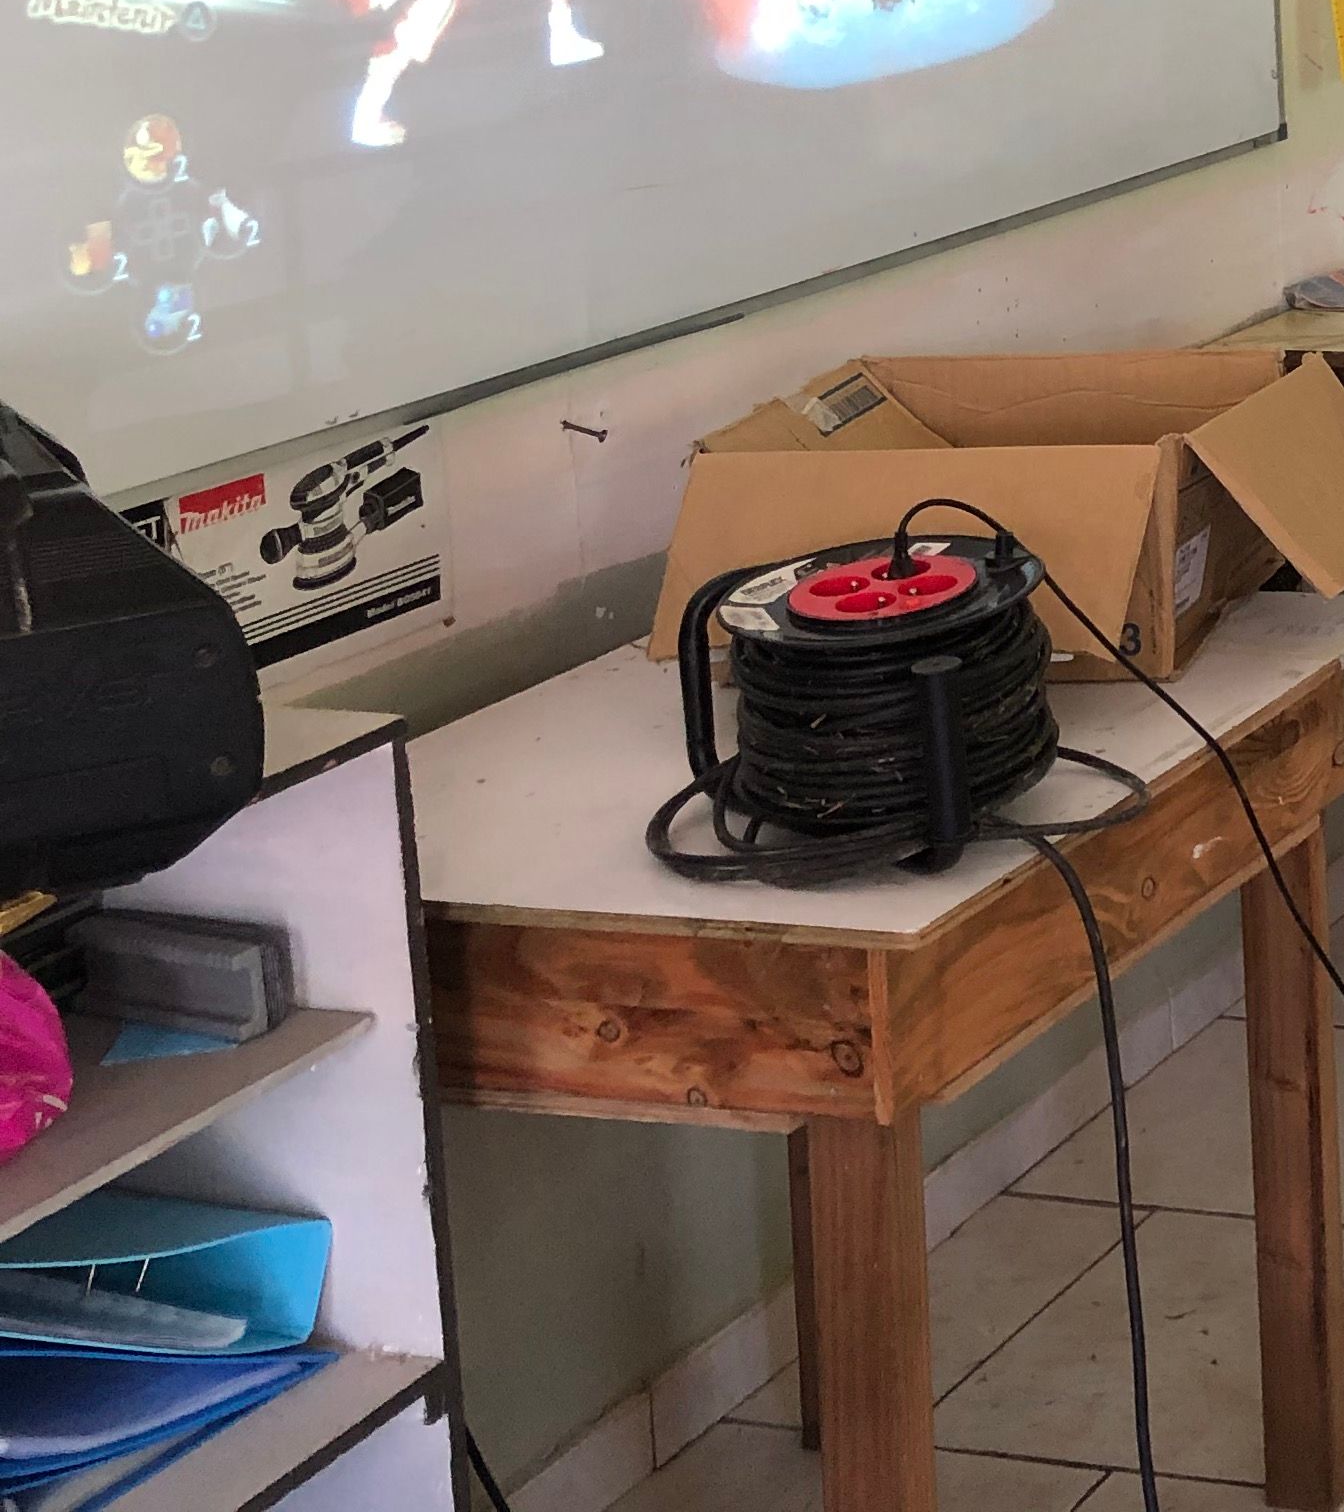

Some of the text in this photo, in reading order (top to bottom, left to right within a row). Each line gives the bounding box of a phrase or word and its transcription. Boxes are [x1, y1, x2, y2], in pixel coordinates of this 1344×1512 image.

[173, 154, 189, 182] 2
[246, 219, 260, 246] 2
[112, 251, 128, 280] 2
[186, 313, 201, 341] 2
[1120, 623, 1141, 656] 3
